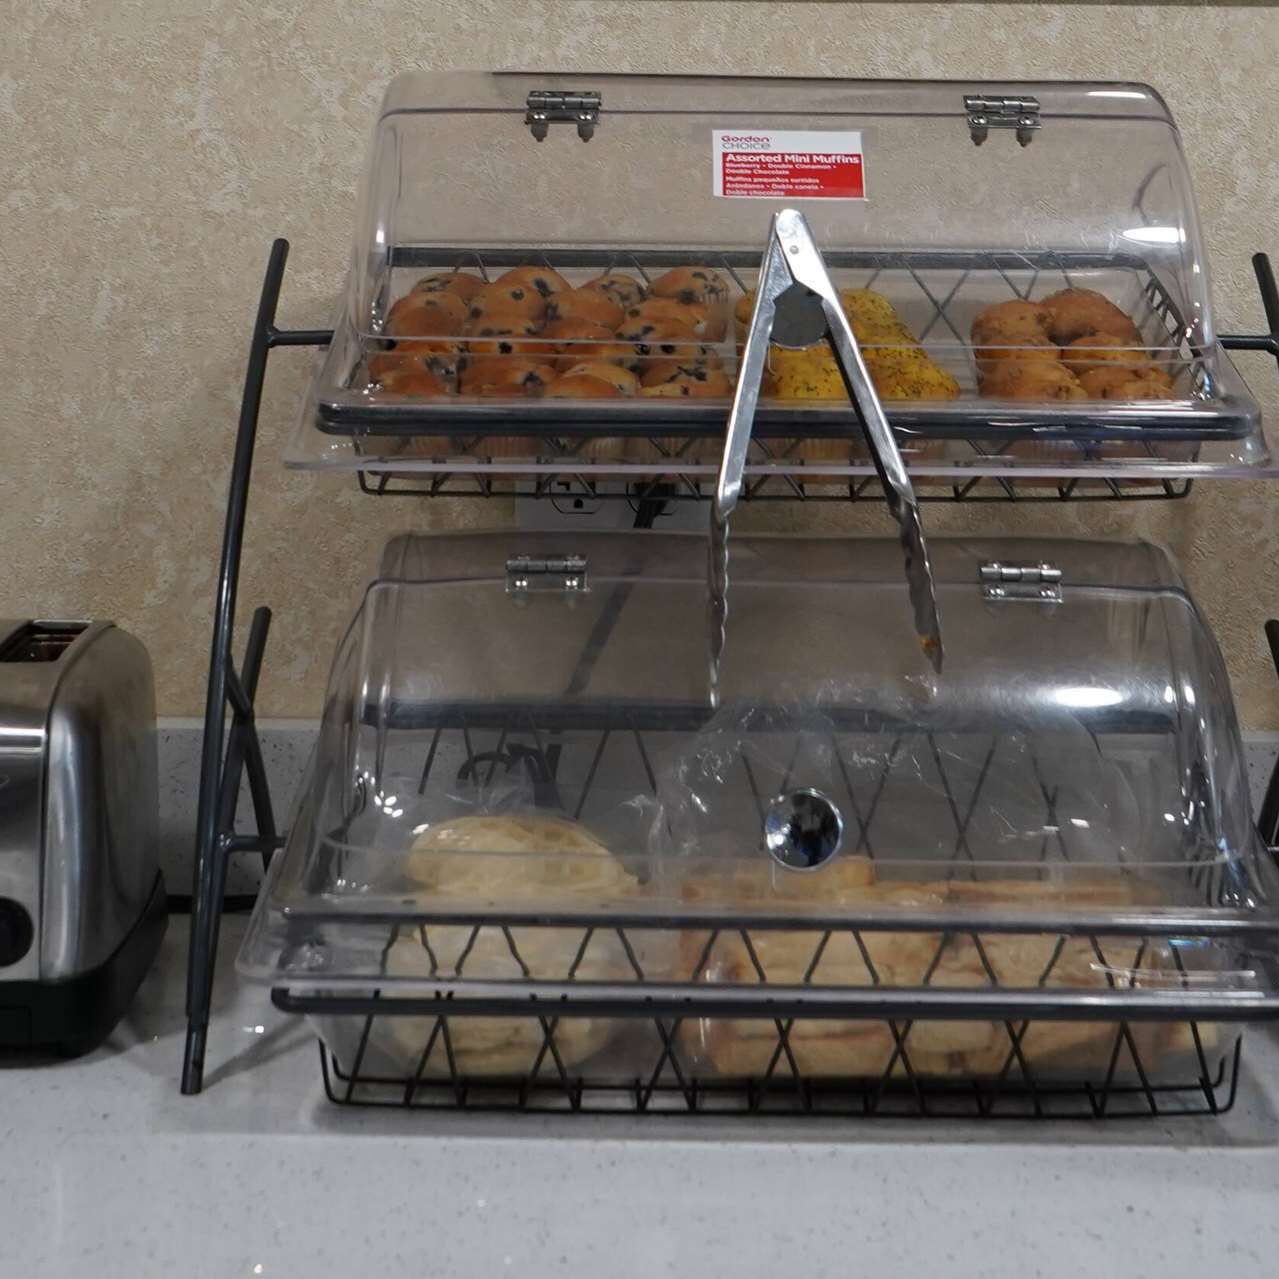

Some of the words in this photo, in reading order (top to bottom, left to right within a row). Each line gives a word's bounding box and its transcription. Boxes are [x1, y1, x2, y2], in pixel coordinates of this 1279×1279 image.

[725, 153, 781, 163] Assorted
[784, 154, 810, 163] Mini
[812, 154, 860, 164] Muffins
